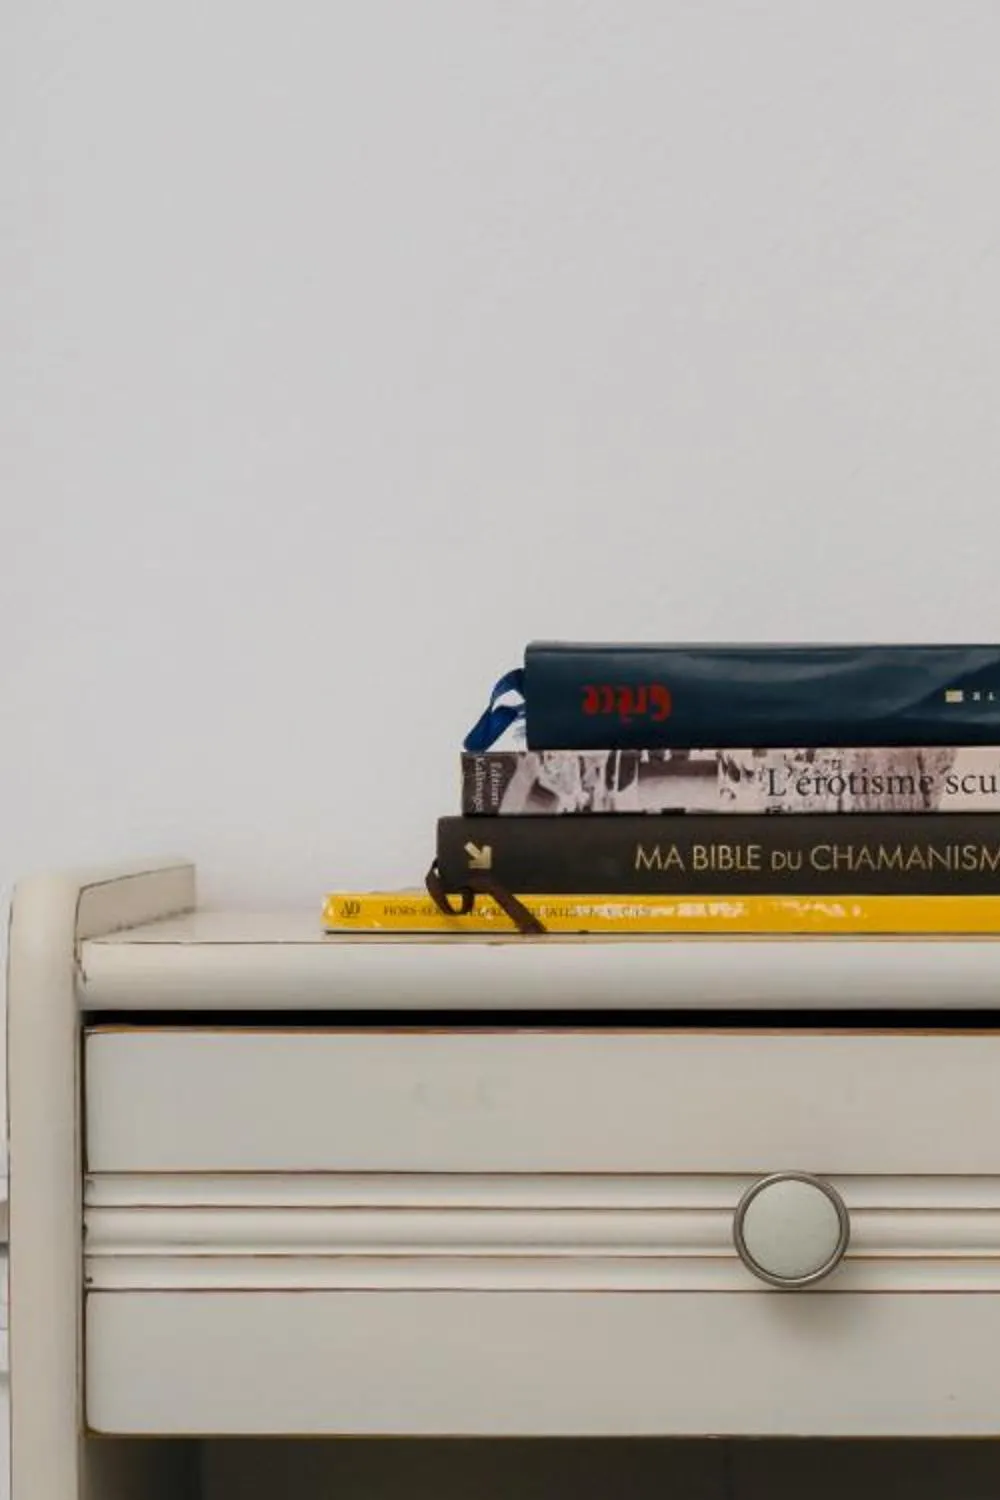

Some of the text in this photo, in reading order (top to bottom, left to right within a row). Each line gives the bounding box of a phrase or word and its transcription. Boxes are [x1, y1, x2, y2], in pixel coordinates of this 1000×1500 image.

[767, 766, 934, 797] L'érotisme
[635, 844, 684, 871] MA
[692, 844, 762, 871] BIBLE
[771, 849, 801, 871] DU
